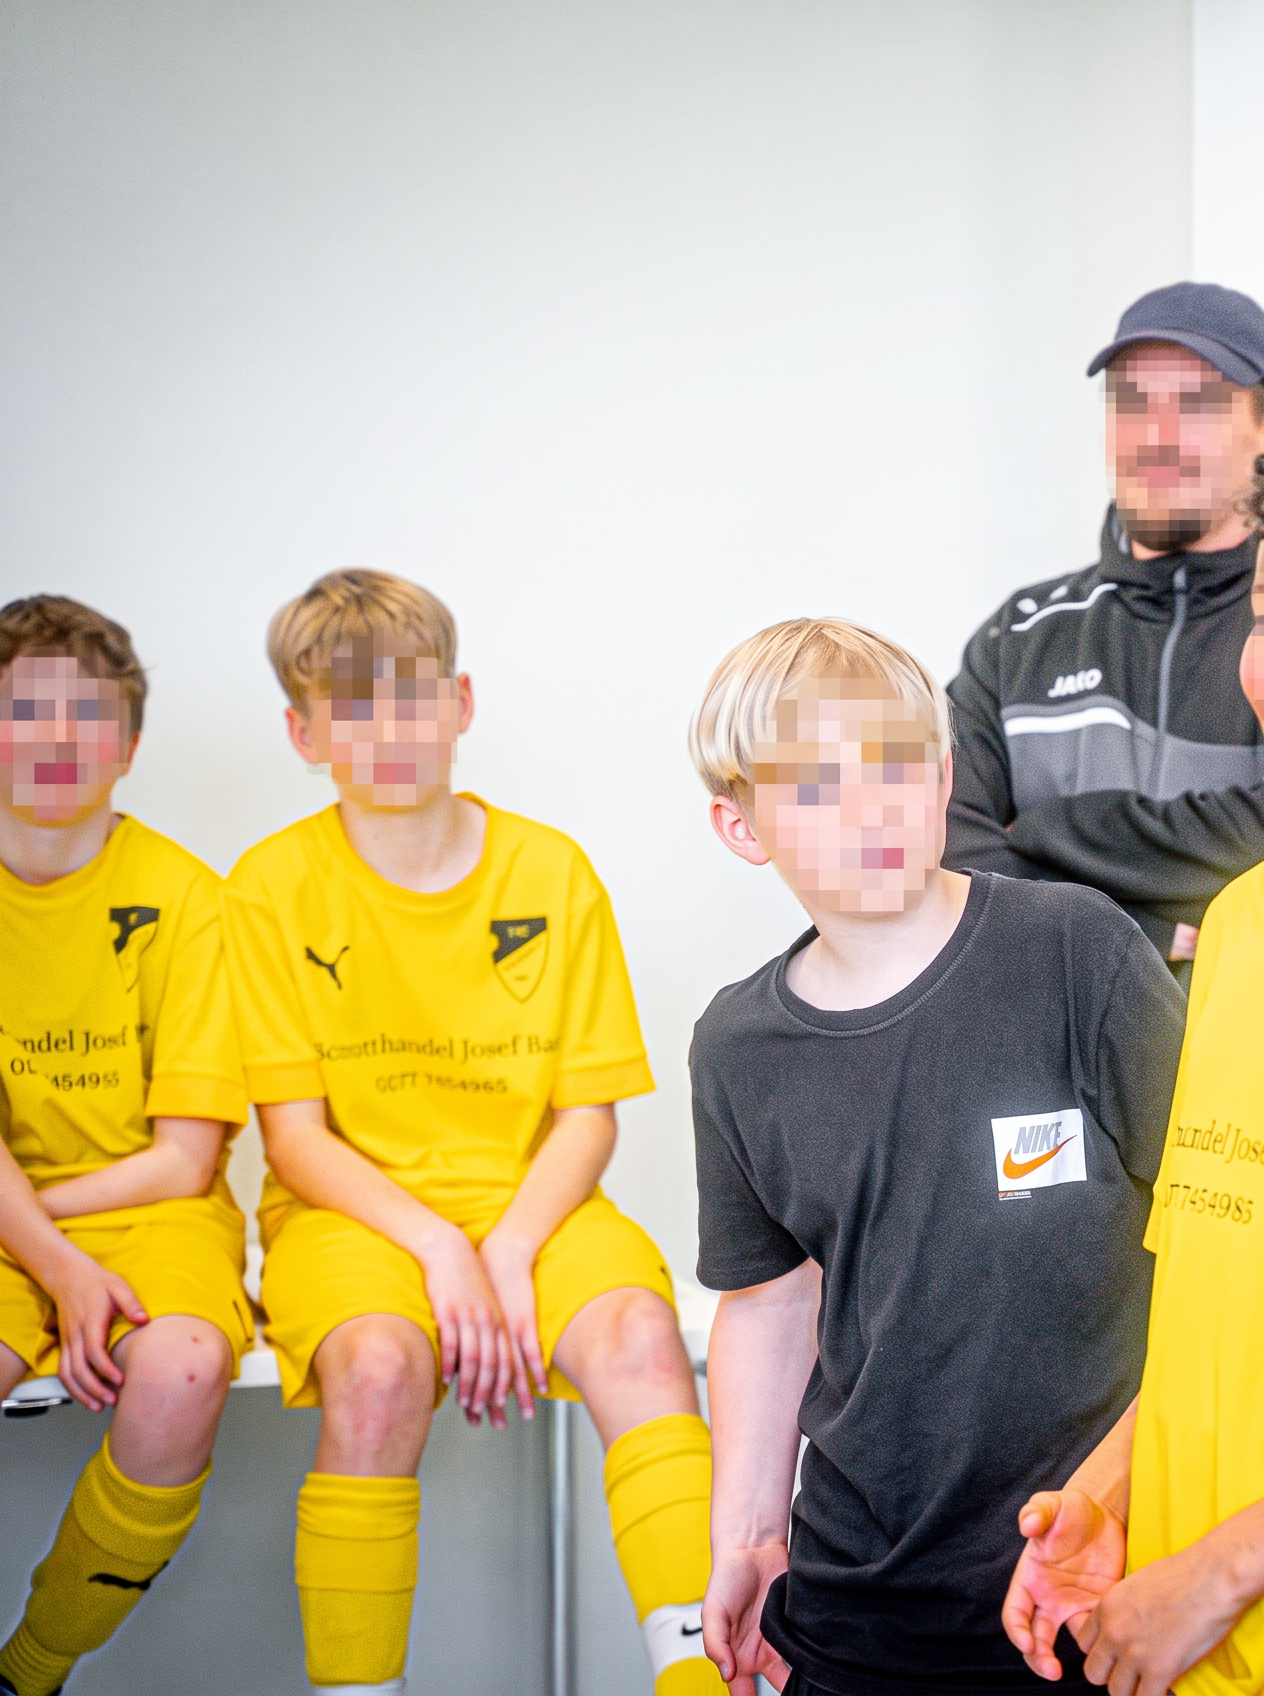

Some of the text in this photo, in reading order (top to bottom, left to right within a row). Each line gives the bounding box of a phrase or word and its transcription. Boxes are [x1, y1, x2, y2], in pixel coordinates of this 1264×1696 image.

[1047, 668, 1103, 698] JAKO
[460, 1034, 521, 1065] Josef
[1013, 1121, 1063, 1155] NIKE
